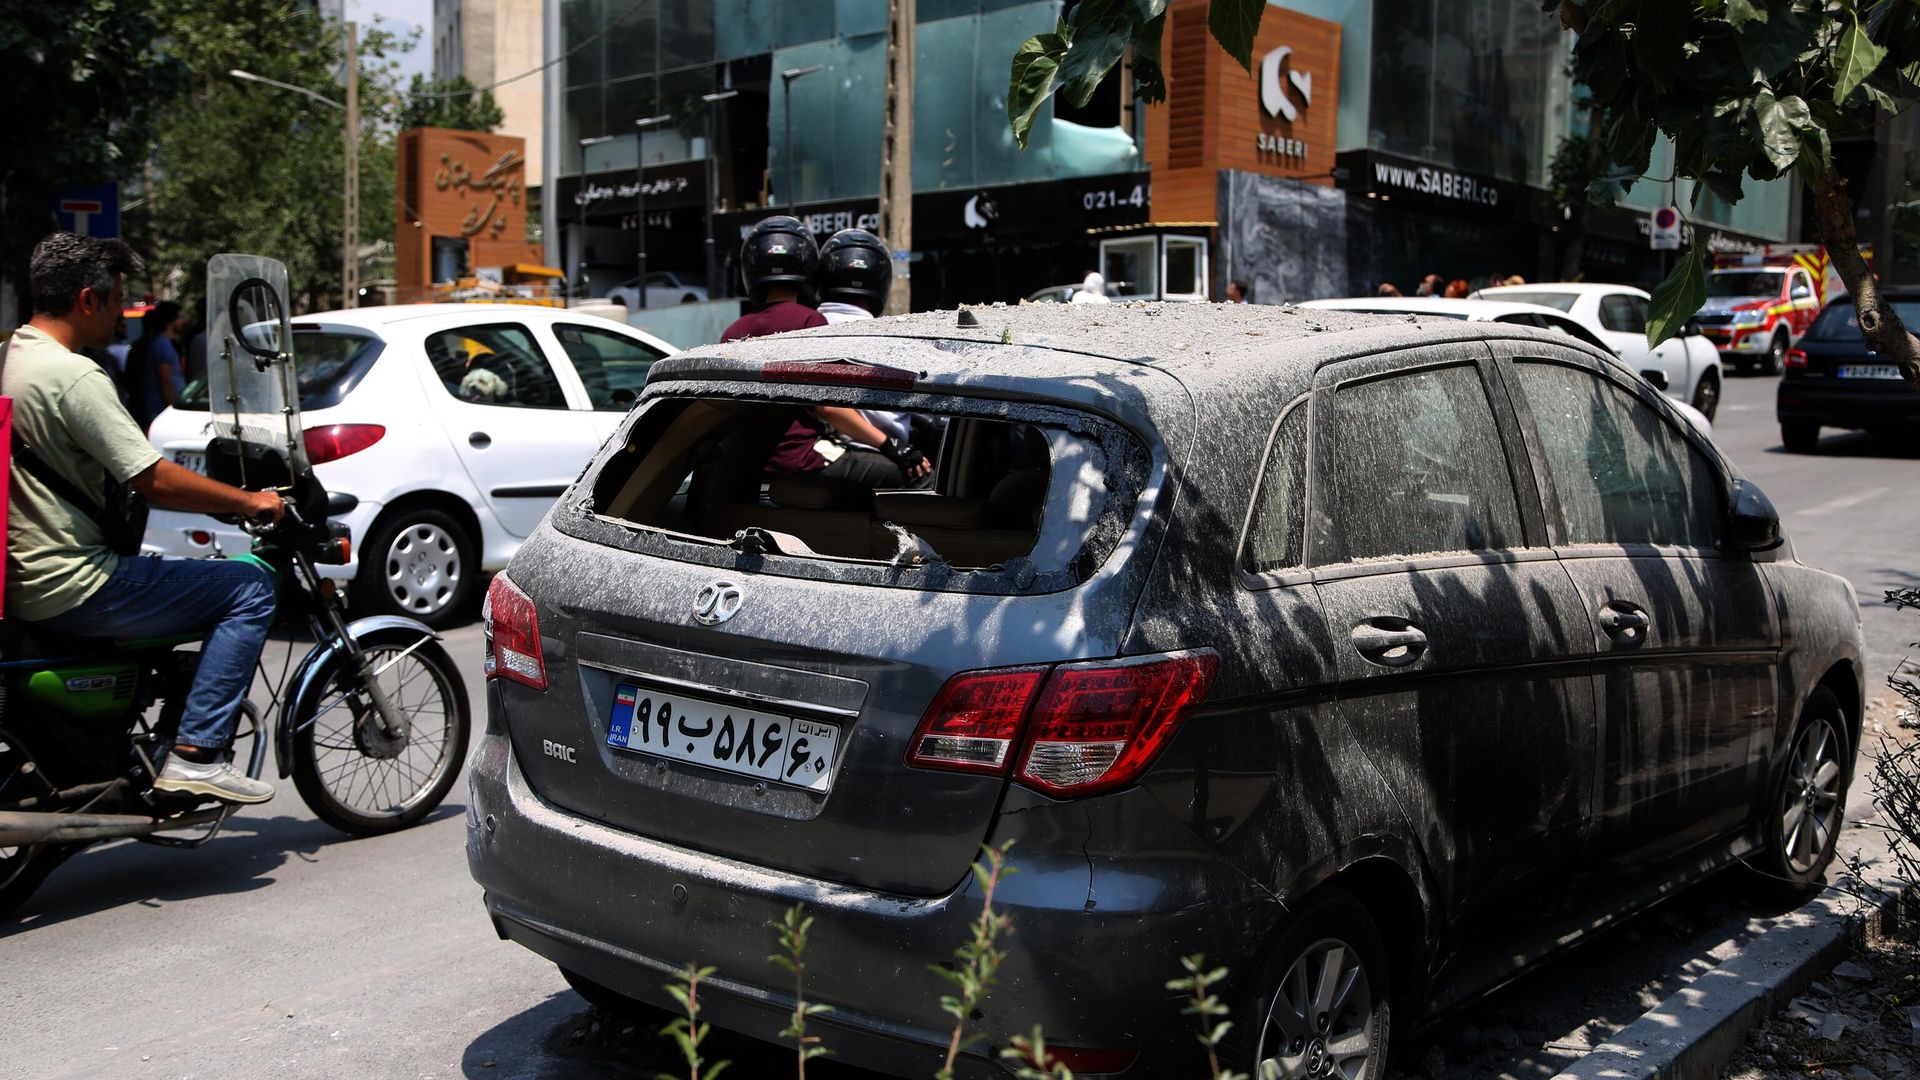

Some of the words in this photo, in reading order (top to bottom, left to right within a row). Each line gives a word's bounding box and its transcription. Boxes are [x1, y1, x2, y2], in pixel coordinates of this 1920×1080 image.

[1257, 133, 1308, 158] SABERI
[609, 733, 628, 744] IRAN
[797, 723, 832, 740] ایران
[543, 739, 577, 764] BAIC
